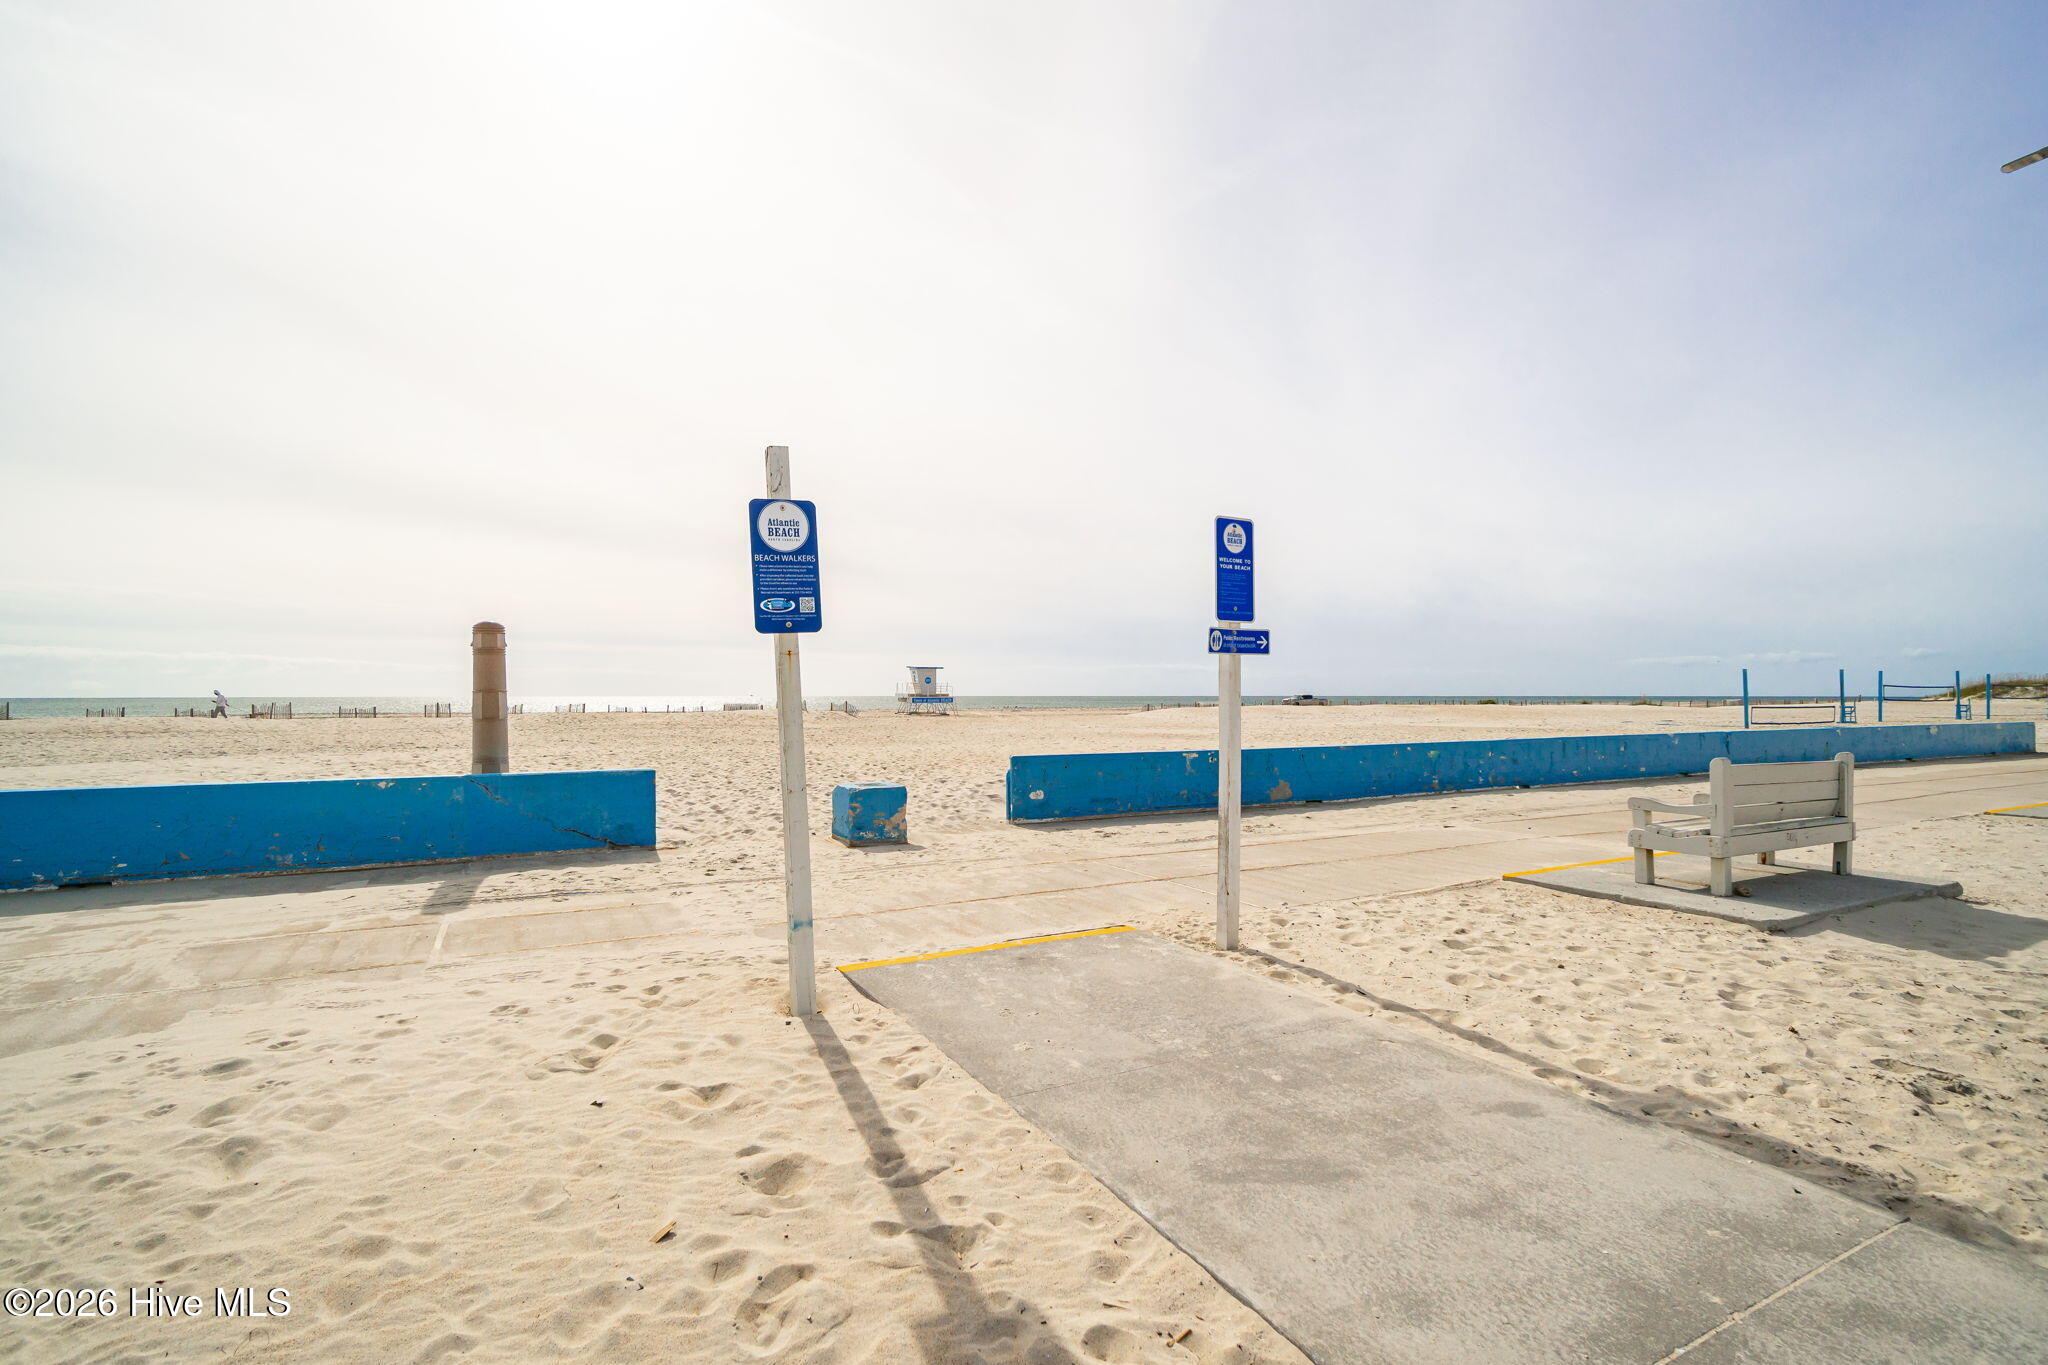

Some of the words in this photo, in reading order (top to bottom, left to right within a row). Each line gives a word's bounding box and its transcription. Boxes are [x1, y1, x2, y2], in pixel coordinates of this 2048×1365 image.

[768, 518, 800, 527] Atlantic
[767, 527, 800, 538] BEACH
[754, 554, 780, 562] BEACH
[781, 554, 816, 562] WALKERS
